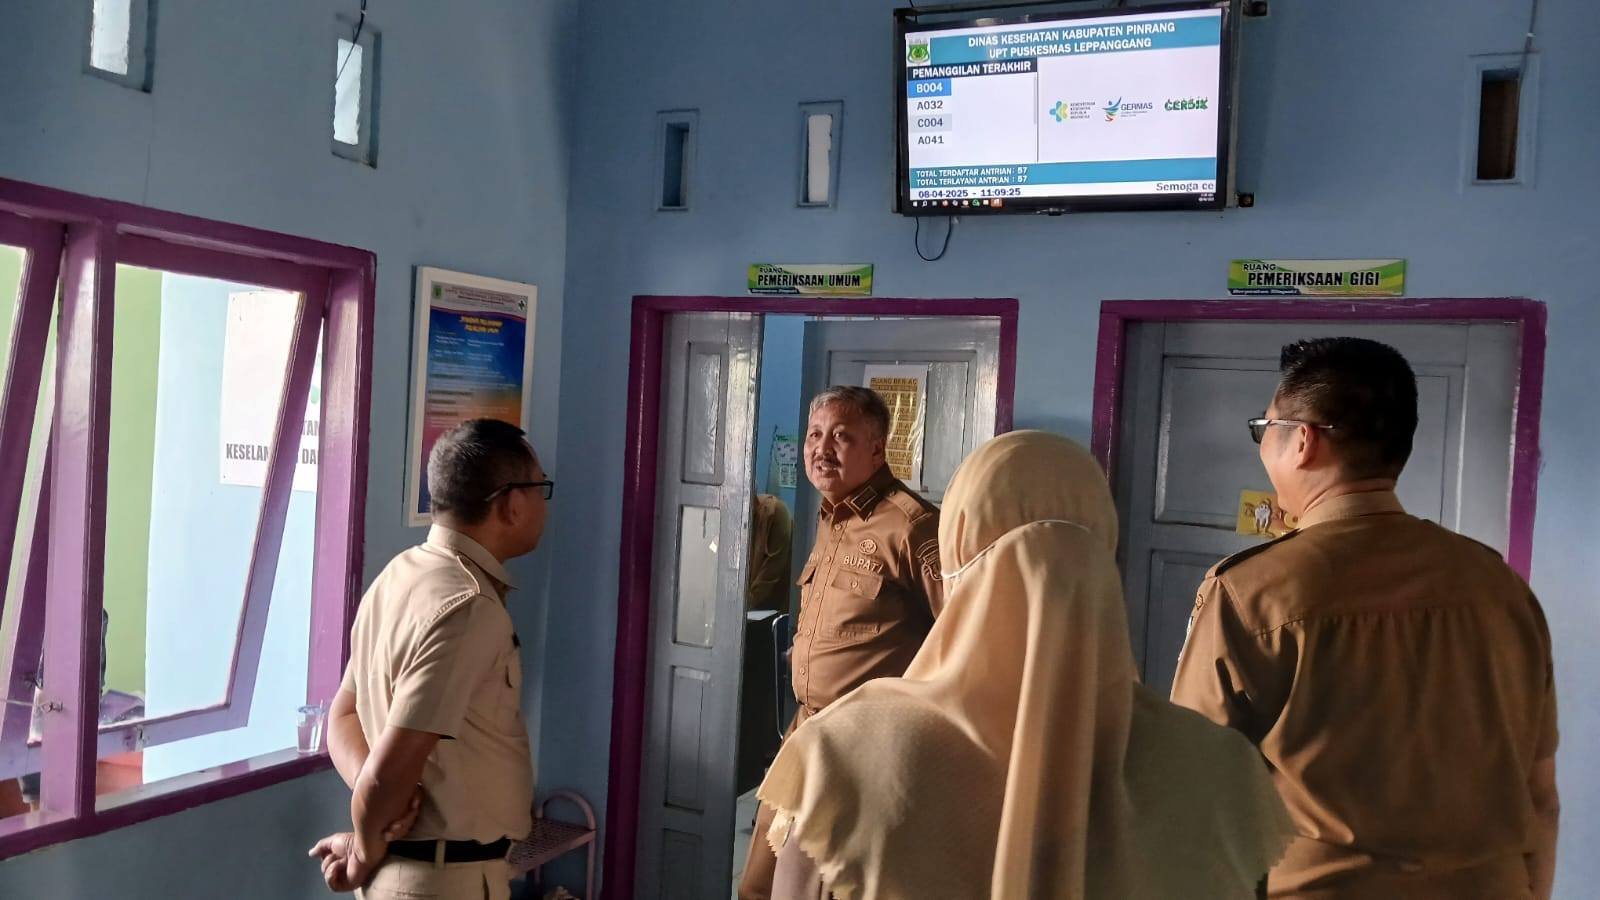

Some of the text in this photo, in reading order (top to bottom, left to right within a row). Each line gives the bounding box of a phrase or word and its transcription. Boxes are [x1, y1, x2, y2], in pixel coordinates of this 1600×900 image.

[968, 22, 1176, 47] DINAS KESEHATAN KABUPATEN PINRANG
[989, 38, 1152, 59] UPT PUSKESMAS LEPPANGGANG
[912, 61, 1031, 79] PEMANGGILAN TERAKHIR
[916, 82, 943, 93] B004
[917, 100, 943, 110] A032
[1120, 102, 1153, 111] GERMAS
[917, 118, 943, 128] C004
[917, 136, 944, 145] A041
[916, 170, 937, 178] TOTAL
[939, 168, 979, 177] TERDAFTAR
[1017, 166, 1028, 174] 57
[939, 177, 977, 186] TERLAYANI
[979, 176, 1009, 184] ANTRIAN
[1017, 175, 1028, 183] 57
[918, 189, 969, 198] 08-04-2025
[980, 187, 1021, 197] 11:09:25
[1155, 182, 1199, 192] Semoga
[1243, 263, 1277, 271] RUANG
[757, 274, 861, 287] PEMERIKSAAN UMUM
[1247, 272, 1380, 287] PEMERIKSAAN GIGI
[302, 448, 317, 464] DA
[843, 555, 884, 574] BUPATI
